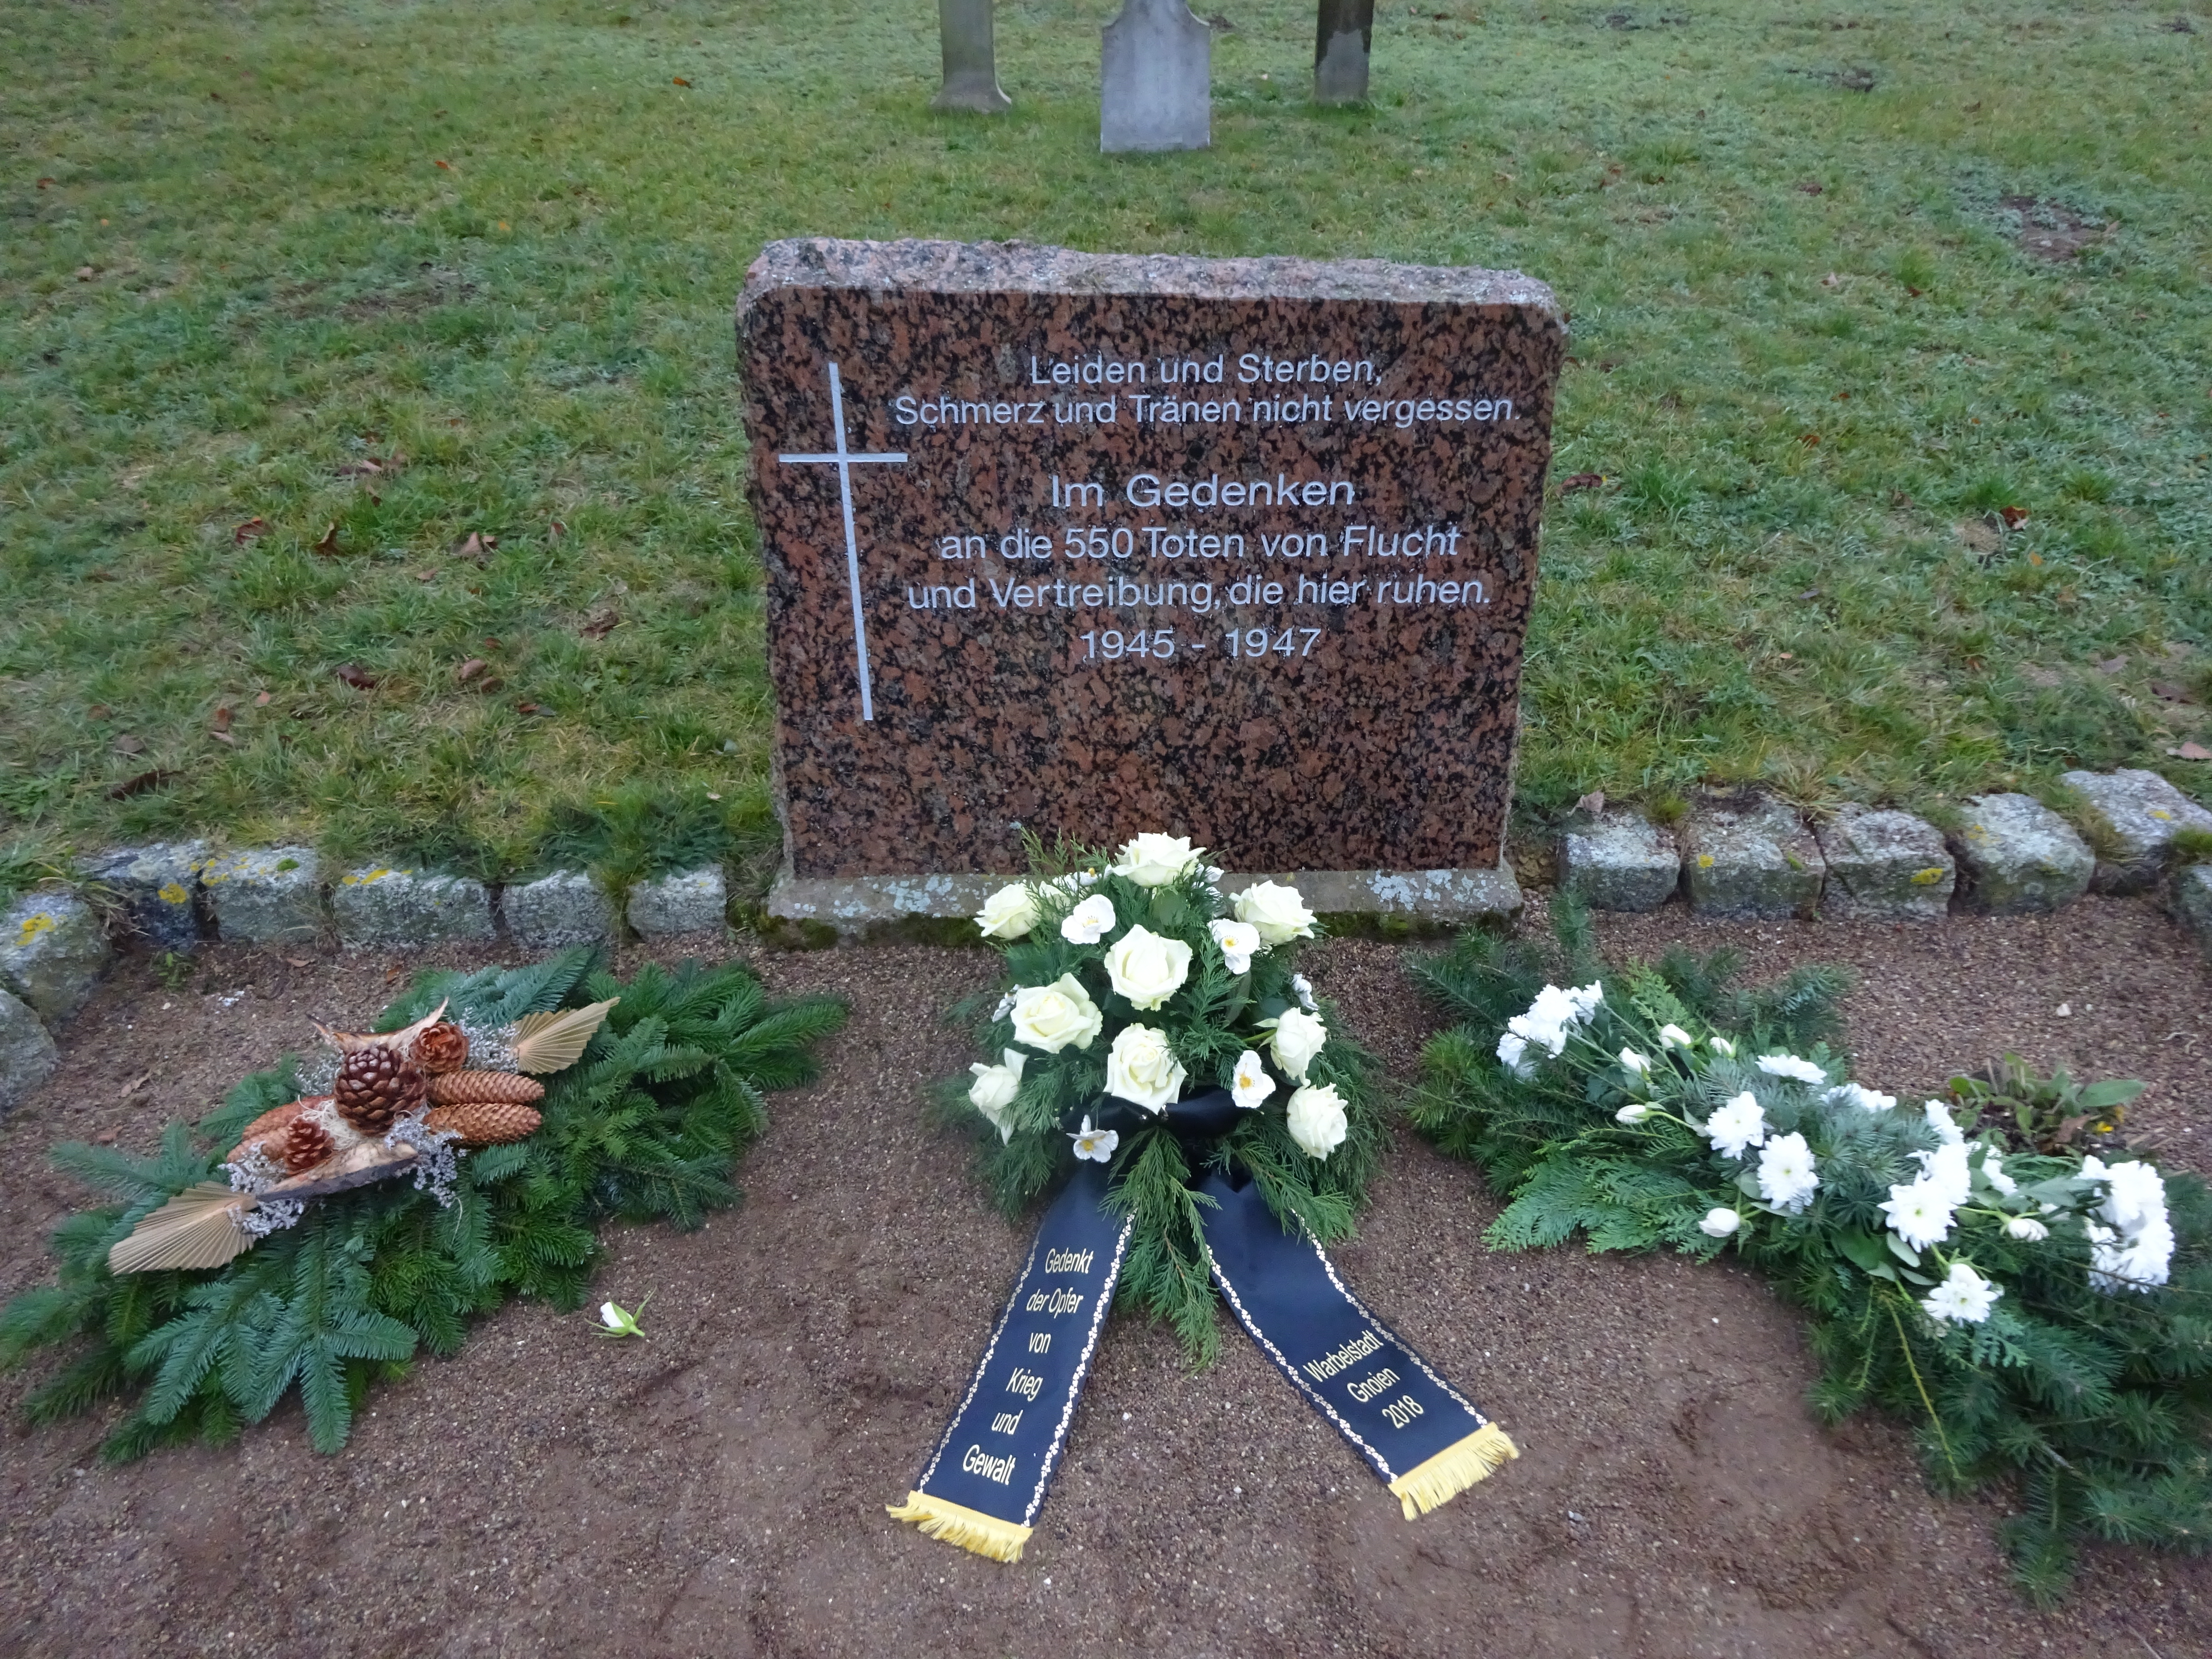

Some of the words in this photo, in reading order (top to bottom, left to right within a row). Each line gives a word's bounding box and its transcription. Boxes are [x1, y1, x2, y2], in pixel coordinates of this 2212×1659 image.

[1031, 356, 1146, 385] Leiden
[1160, 355, 1224, 384] und
[1237, 354, 1383, 387] Sterben,
[895, 397, 1044, 425] Schmerz
[1054, 396, 1117, 423] und
[1129, 394, 1240, 422] Tränen
[1253, 394, 1331, 422] nicht
[1344, 396, 1520, 428] vergessen.
[1051, 475, 1104, 507] Im
[1126, 473, 1355, 507] Gedenken
[941, 534, 987, 559] an
[1000, 530, 1053, 559] die
[1065, 528, 1134, 558] 550
[1143, 527, 1244, 558] Toten
[1261, 532, 1328, 557] von
[1343, 525, 1460, 557] Flucht
[908, 580, 976, 609] und
[992, 577, 1221, 614] Vertreibung,
[1229, 576, 1284, 605] die
[1298, 575, 1364, 605] hier
[1377, 574, 1491, 604] ruhen.
[1082, 630, 1175, 658] 1945
[1226, 628, 1321, 656] 1947
[1045, 1248, 1093, 1274] Gedenkt
[1026, 1289, 1049, 1312] der
[1049, 1287, 1083, 1318] Opfer
[1029, 1332, 1051, 1354] von
[1303, 1330, 1384, 1382] Warbelstadt
[1006, 1368, 1043, 1401] Krieg
[1347, 1367, 1400, 1402] Gnoien
[992, 1410, 1023, 1435] und
[1382, 1395, 1424, 1429] 2018
[963, 1445, 1016, 1485] Gewalt
